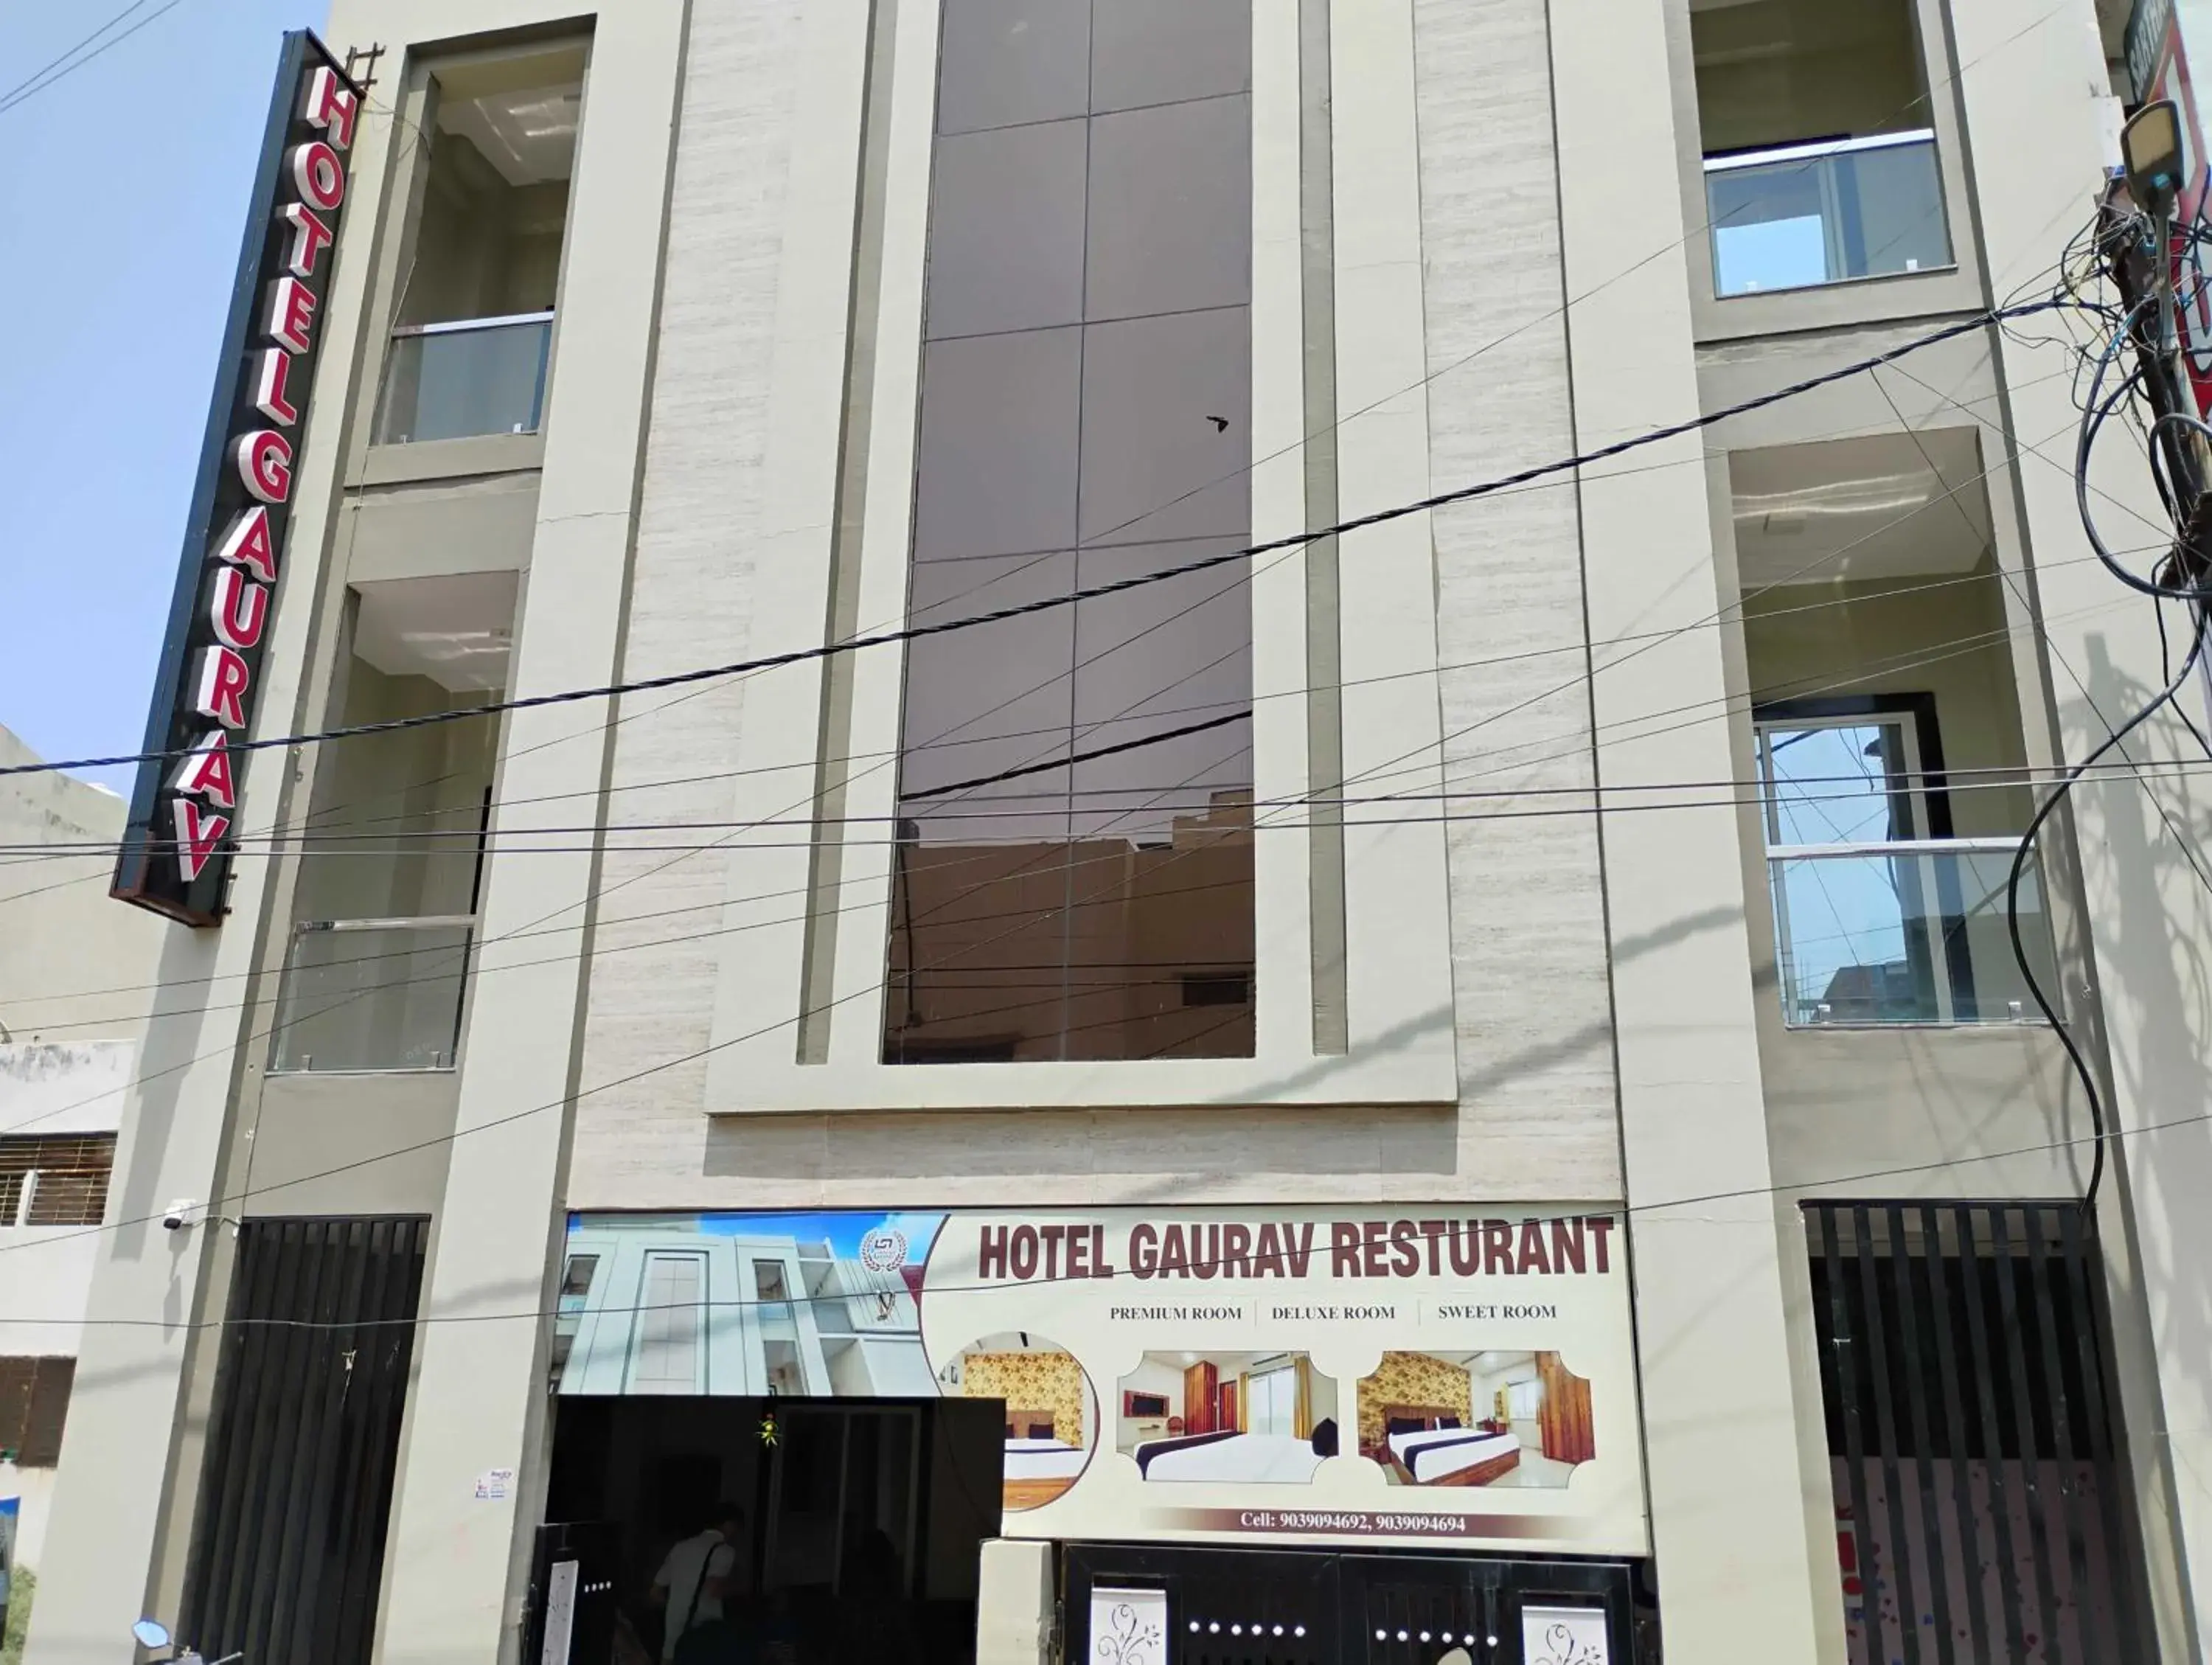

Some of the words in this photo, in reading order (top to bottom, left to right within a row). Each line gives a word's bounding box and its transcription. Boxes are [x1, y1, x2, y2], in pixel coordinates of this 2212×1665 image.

[257, 66, 357, 427] HOTEL
[173, 429, 293, 883] GAURAV
[978, 1224, 1114, 1280] HOTEL
[1129, 1222, 1315, 1280] GAURAV
[1330, 1217, 1615, 1278] RESTURANT
[1110, 1306, 1187, 1320] PREMIUM
[1192, 1306, 1242, 1320] ROOM
[1272, 1306, 1339, 1320] DELUXE
[1343, 1305, 1396, 1319] ROOM
[1439, 1304, 1498, 1319] SWEET
[1503, 1304, 1557, 1319] ROOM
[1240, 1512, 1276, 1527] Cell:
[1279, 1513, 1372, 1532] 9039094692,
[1376, 1515, 1467, 1532] 9039094694
